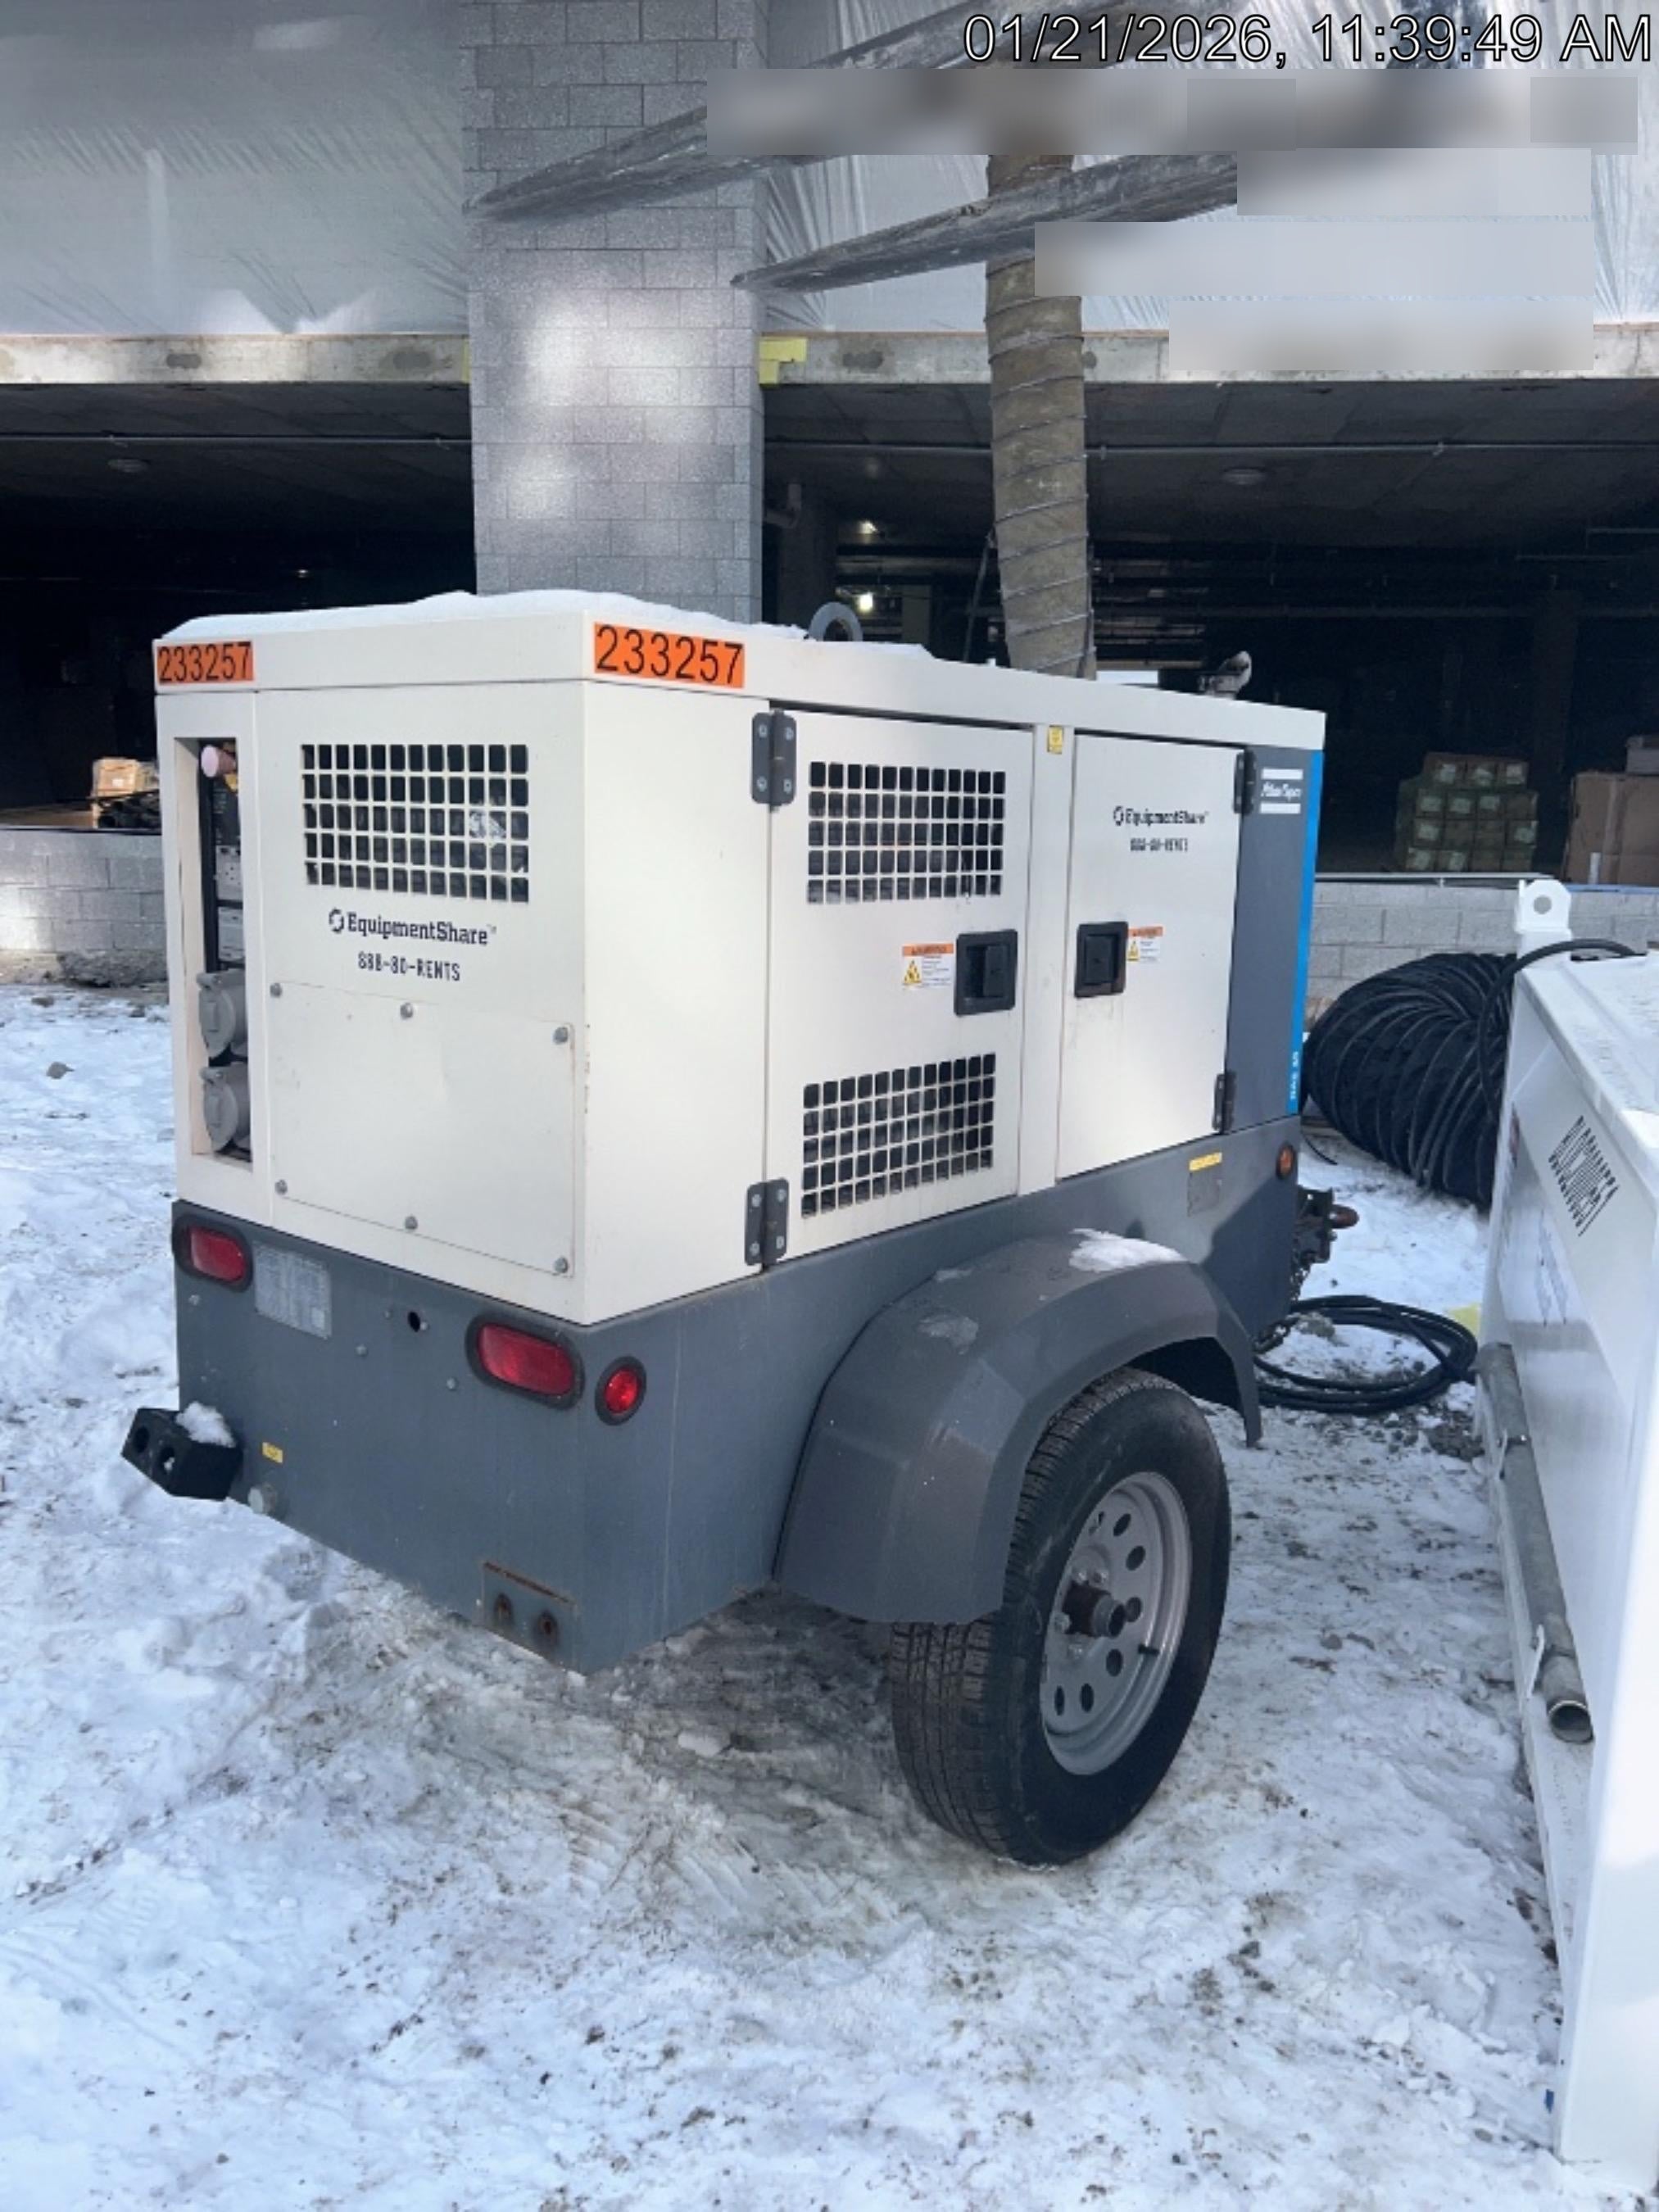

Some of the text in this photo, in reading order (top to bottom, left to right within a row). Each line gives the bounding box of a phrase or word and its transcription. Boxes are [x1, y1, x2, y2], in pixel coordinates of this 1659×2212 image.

[159, 641, 251, 682] 233257
[596, 623, 743, 684] 233257
[347, 911, 489, 945] EquipmentShare
